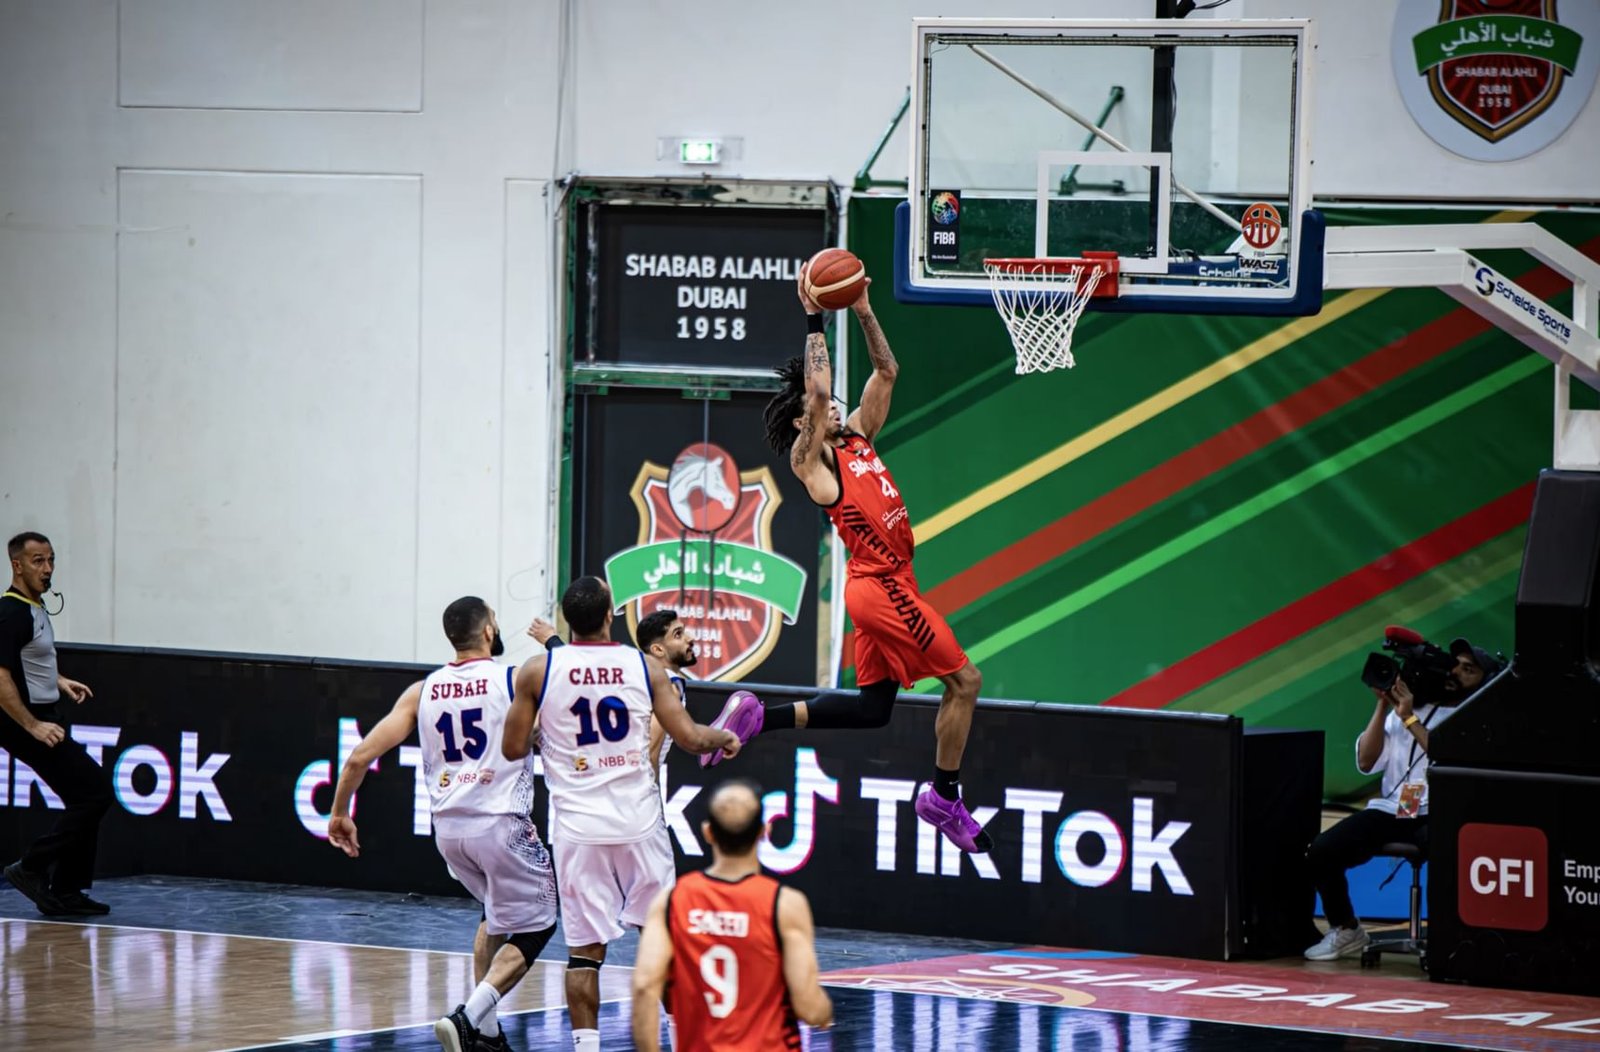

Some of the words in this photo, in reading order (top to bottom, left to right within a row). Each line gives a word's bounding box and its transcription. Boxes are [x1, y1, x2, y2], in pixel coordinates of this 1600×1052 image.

[1440, 21, 1497, 57] الأهلي
[1501, 25, 1555, 49] شباب
[1455, 66, 1499, 77] SHABAB
[1500, 67, 1538, 78] ALAHLI
[1478, 84, 1512, 95] DUBAI
[1478, 97, 1512, 108] 1958
[933, 231, 956, 245] FIBA
[625, 254, 716, 278] SHABAB
[720, 256, 802, 281] ALAHLI
[677, 286, 747, 309] DUBAI
[1495, 280, 1537, 317] Schelde
[1537, 308, 1571, 339] Sports
[676, 316, 747, 340] 1958
[691, 644, 722, 658] 958
[569, 667, 625, 685] CARR
[430, 679, 488, 701] SUBAH
[569, 695, 630, 747] 10
[435, 707, 488, 763] 15
[598, 755, 626, 769] NBB
[457, 772, 478, 784] NBB
[1469, 856, 1534, 898] CFI
[1563, 885, 1600, 905] You
[700, 944, 740, 1019] 9
[957, 964, 1450, 1014] SHABAB
